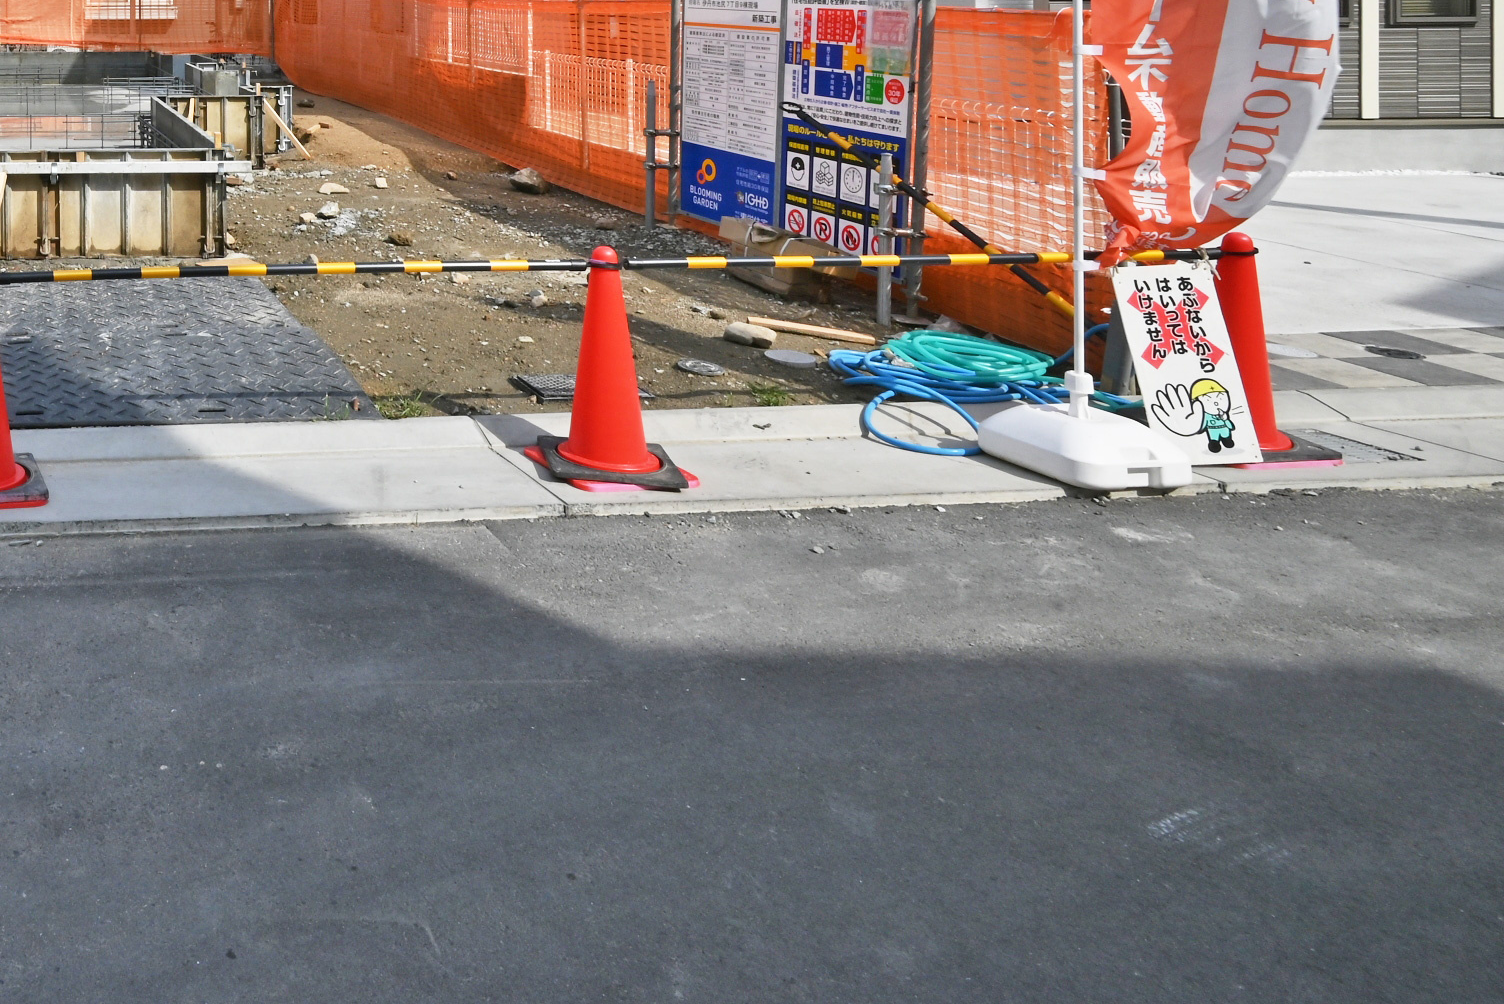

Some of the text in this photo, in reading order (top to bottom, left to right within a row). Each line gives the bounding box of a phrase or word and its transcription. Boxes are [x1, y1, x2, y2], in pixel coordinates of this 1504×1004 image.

[752, 14, 777, 24] 新築工事
[887, 89, 901, 97] 30年
[1216, 28, 1336, 202] Home
[847, 134, 900, 153] 私たちは守ります
[689, 184, 723, 202] BLOOMING
[744, 192, 769, 210] IGHD
[692, 196, 719, 211] GARDEN
[1133, 278, 1167, 359] いけません
[1155, 277, 1189, 355] はいっては
[1177, 275, 1216, 374] あぶないから
